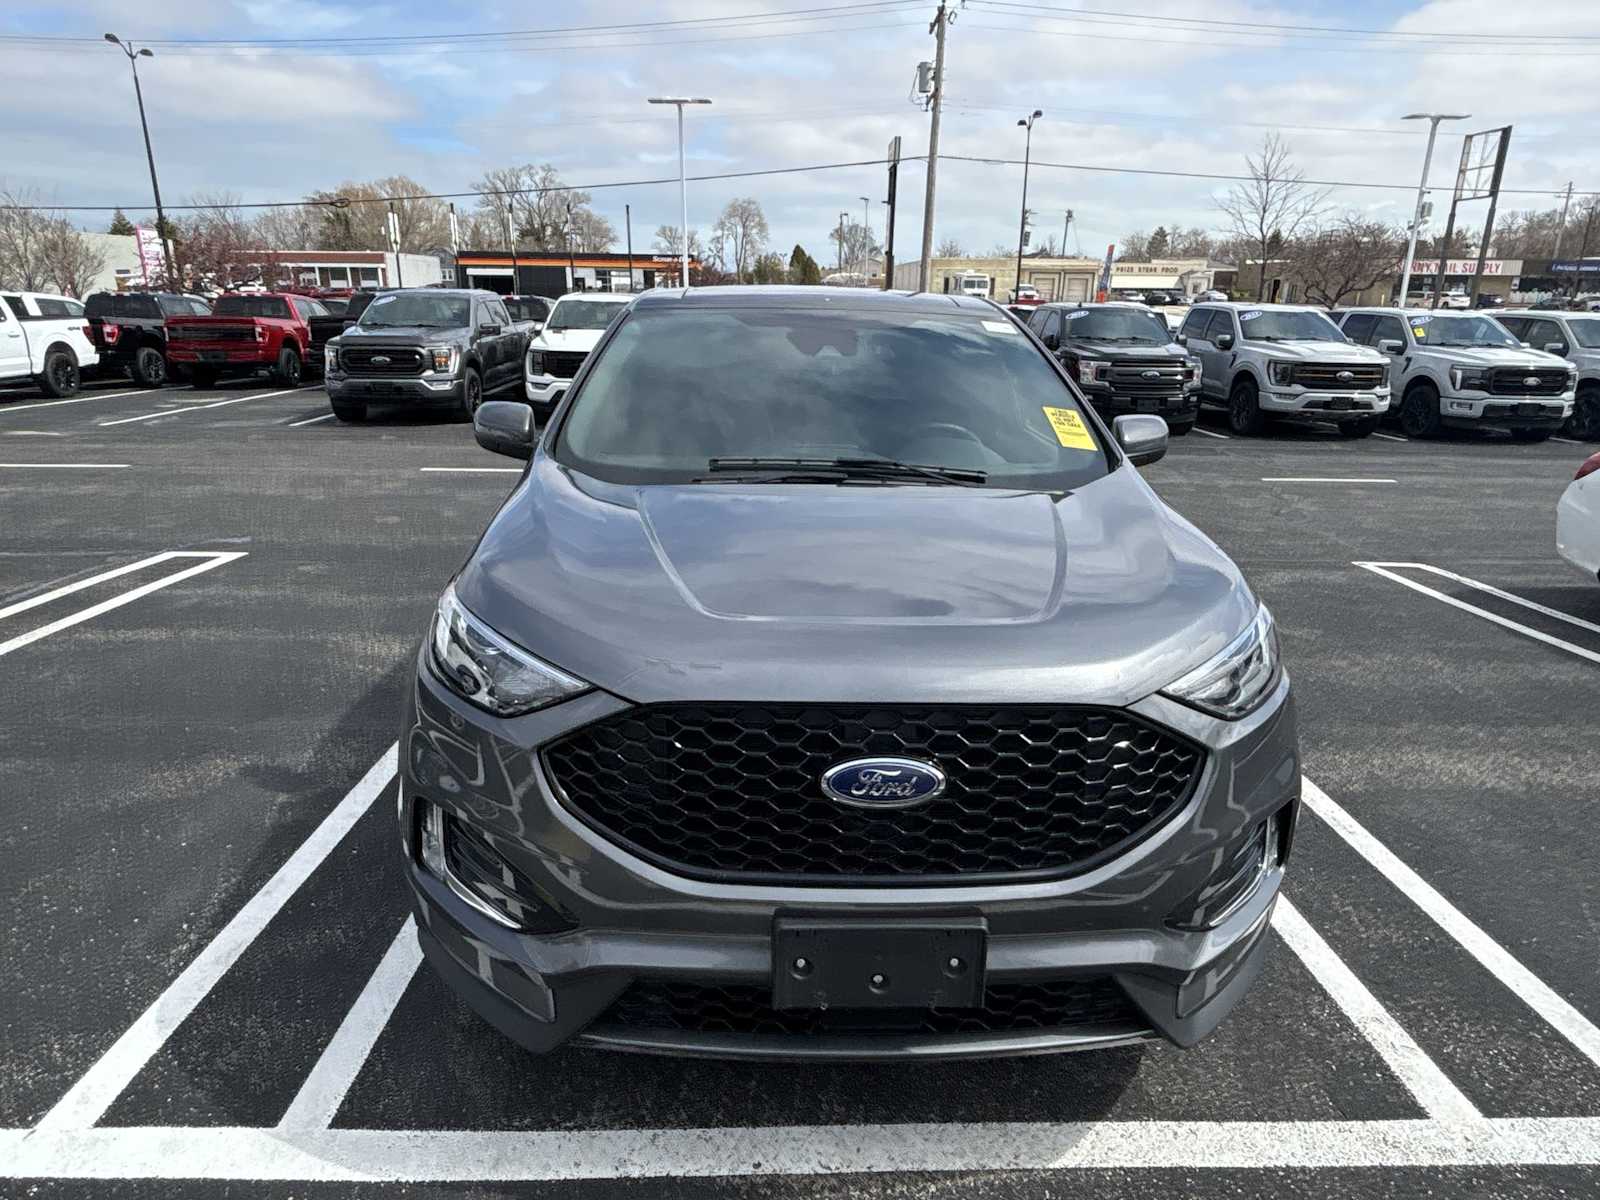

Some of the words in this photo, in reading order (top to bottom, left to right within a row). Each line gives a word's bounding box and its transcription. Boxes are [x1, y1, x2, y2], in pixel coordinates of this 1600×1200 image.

[1396, 262, 1432, 273] SNNY
[1462, 262, 1502, 273] SUPLY
[850, 768, 918, 797] Ford
